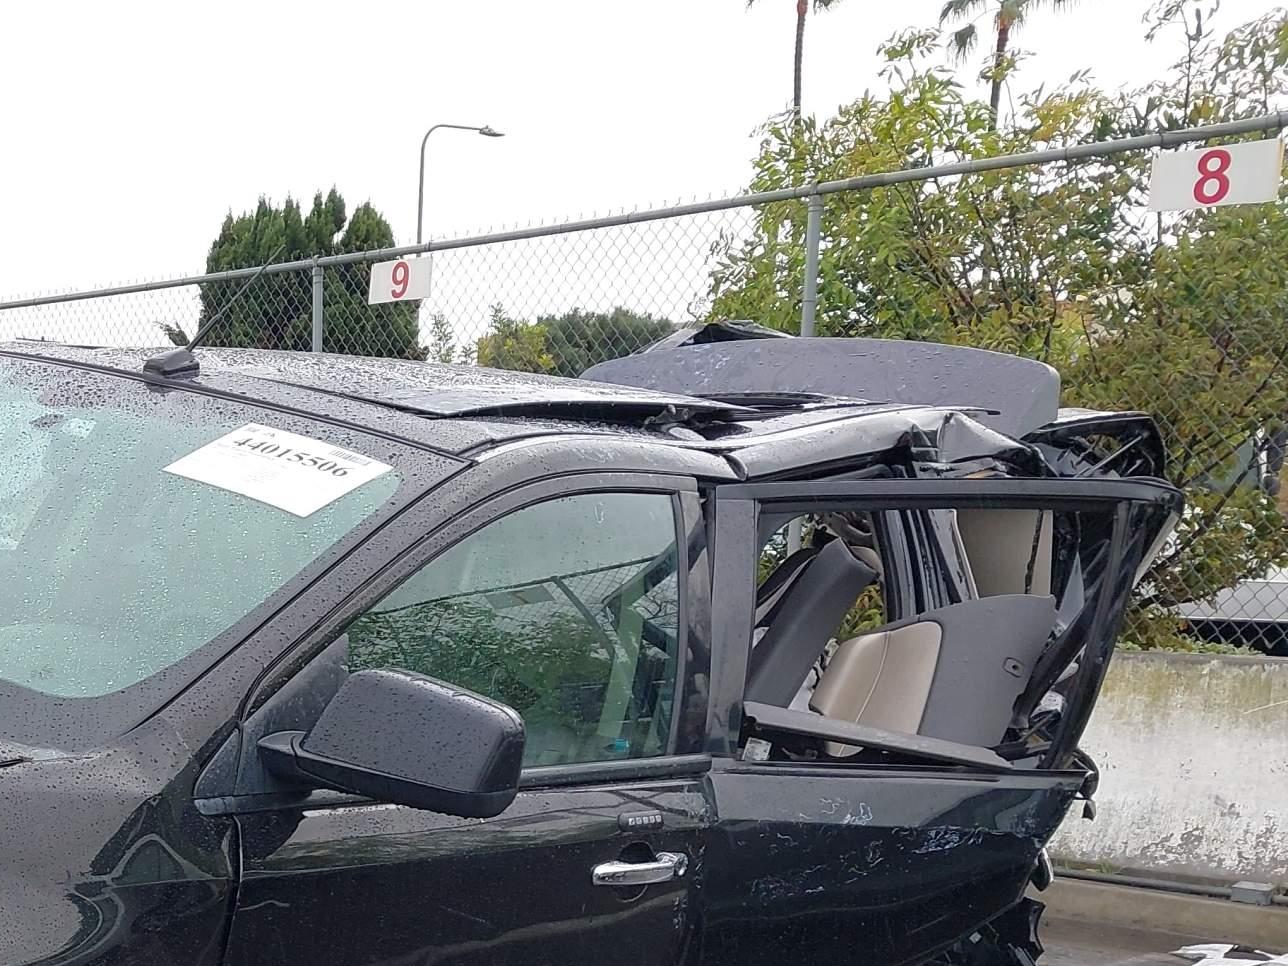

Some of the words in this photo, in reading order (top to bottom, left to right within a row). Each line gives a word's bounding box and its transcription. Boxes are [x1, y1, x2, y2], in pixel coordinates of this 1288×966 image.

[1193, 149, 1231, 204] 8
[391, 261, 409, 298] 9
[233, 438, 352, 476] 44015506
